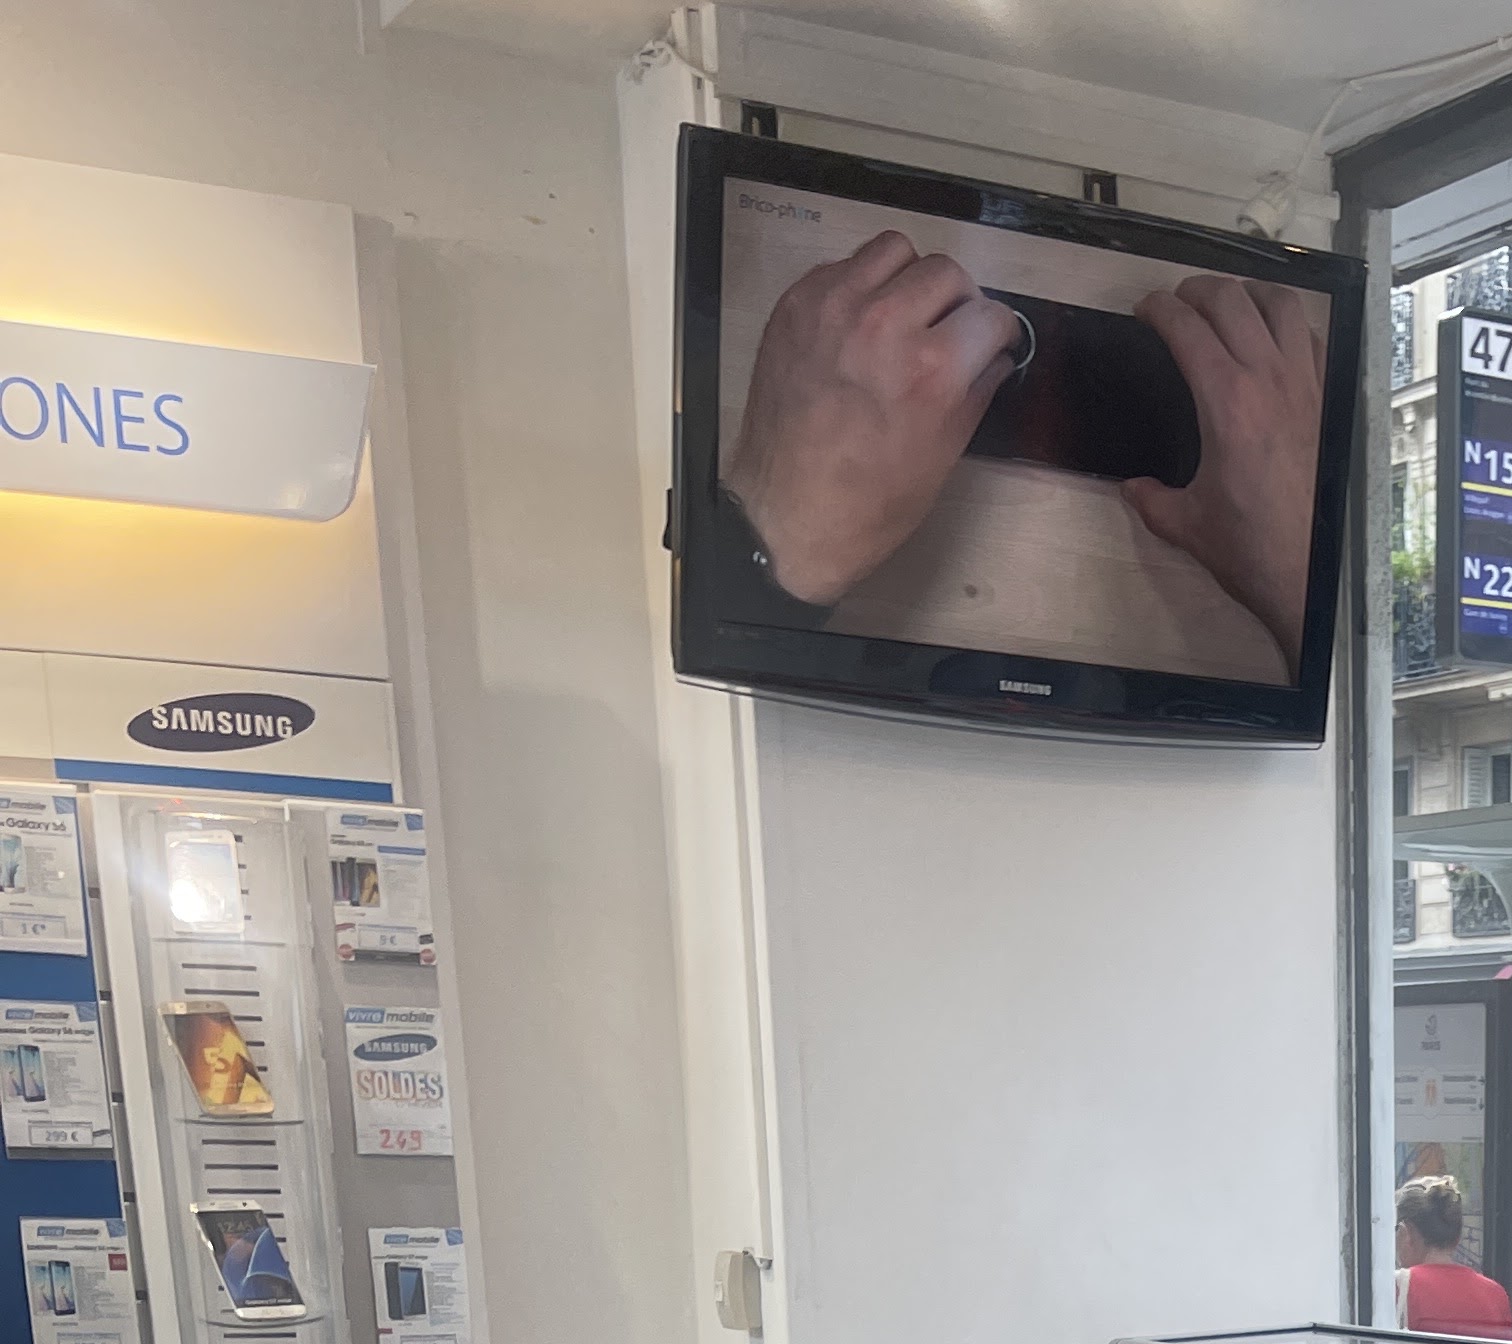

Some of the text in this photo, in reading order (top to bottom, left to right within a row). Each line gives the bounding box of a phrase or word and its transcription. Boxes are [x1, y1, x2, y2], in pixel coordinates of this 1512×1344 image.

[151, 705, 294, 740] SAMSUNG
[347, 1009, 436, 1024] vivre mobile
[356, 1070, 443, 1100] SOLDES
